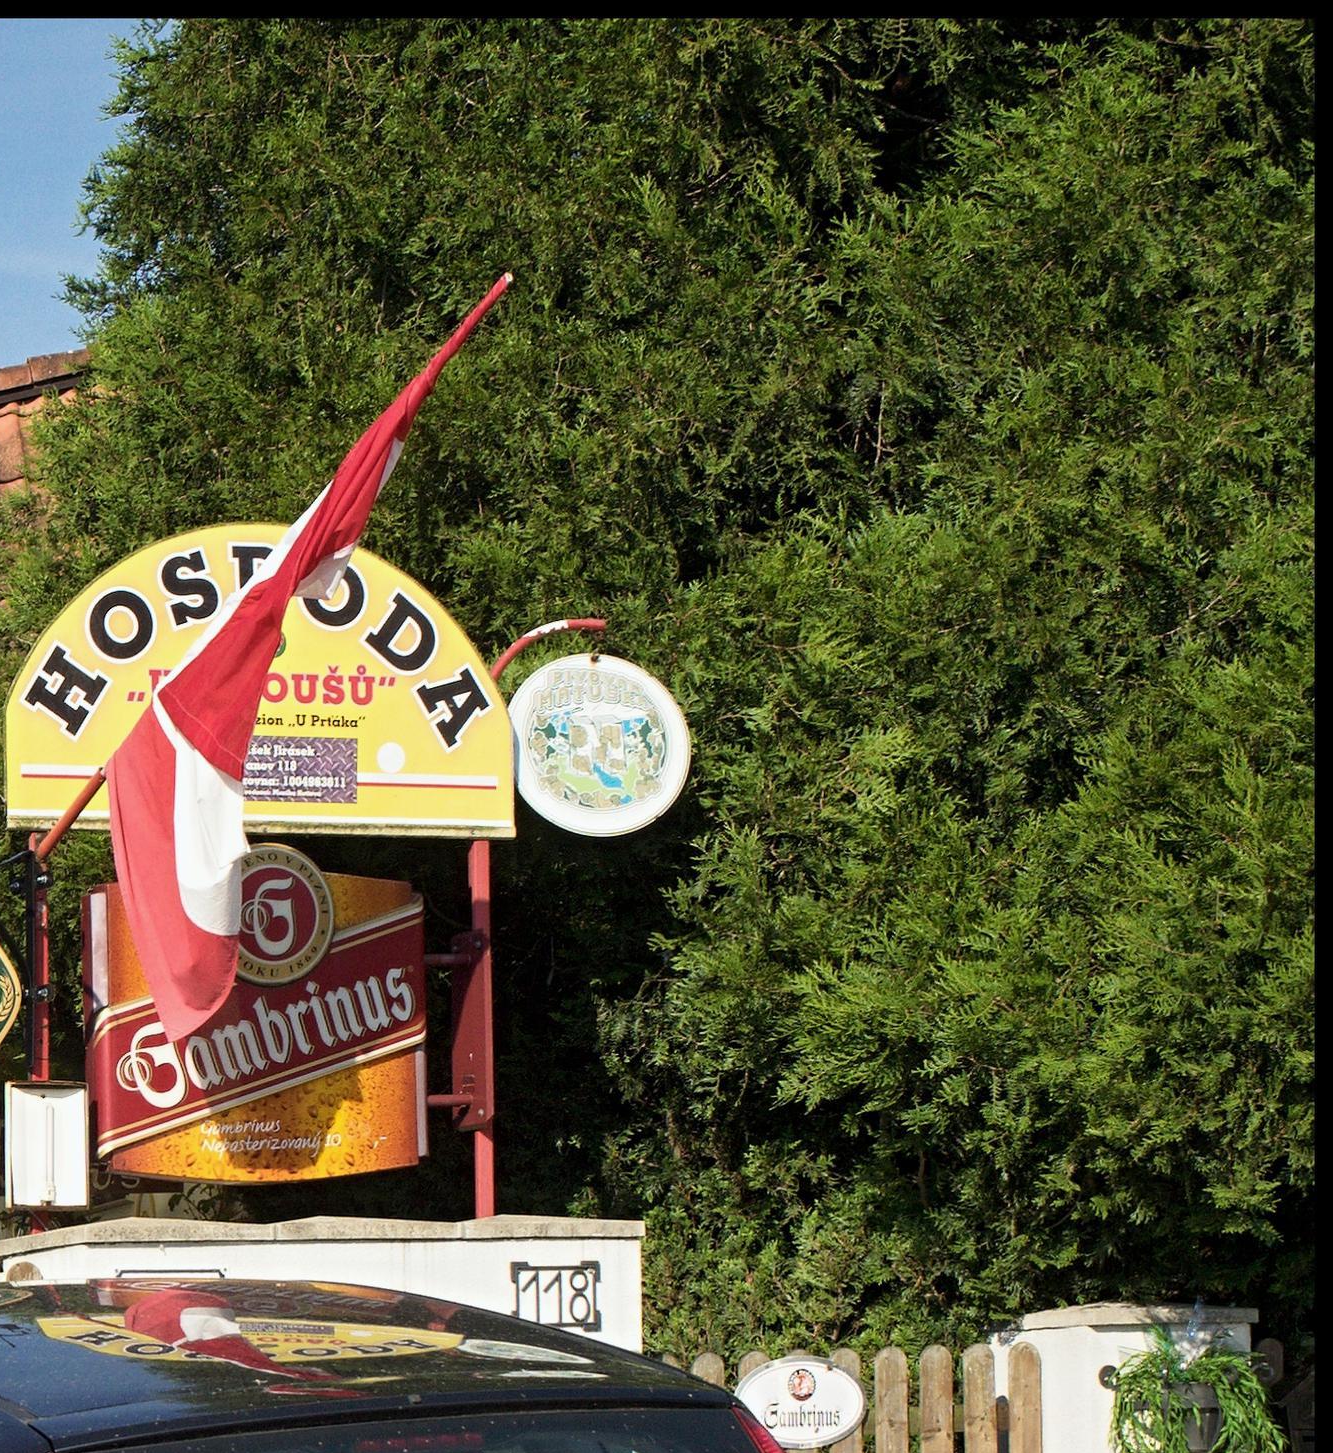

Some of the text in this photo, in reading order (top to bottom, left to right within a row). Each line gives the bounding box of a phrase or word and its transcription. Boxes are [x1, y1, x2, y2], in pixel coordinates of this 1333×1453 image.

[115, 966, 415, 1109] Gambrinus
[200, 1119, 281, 1138] Gambrinus
[201, 1130, 322, 1157] Nepasterizovaný
[520, 1269, 591, 1324] 118
[764, 1402, 841, 1431] Gambrinus
